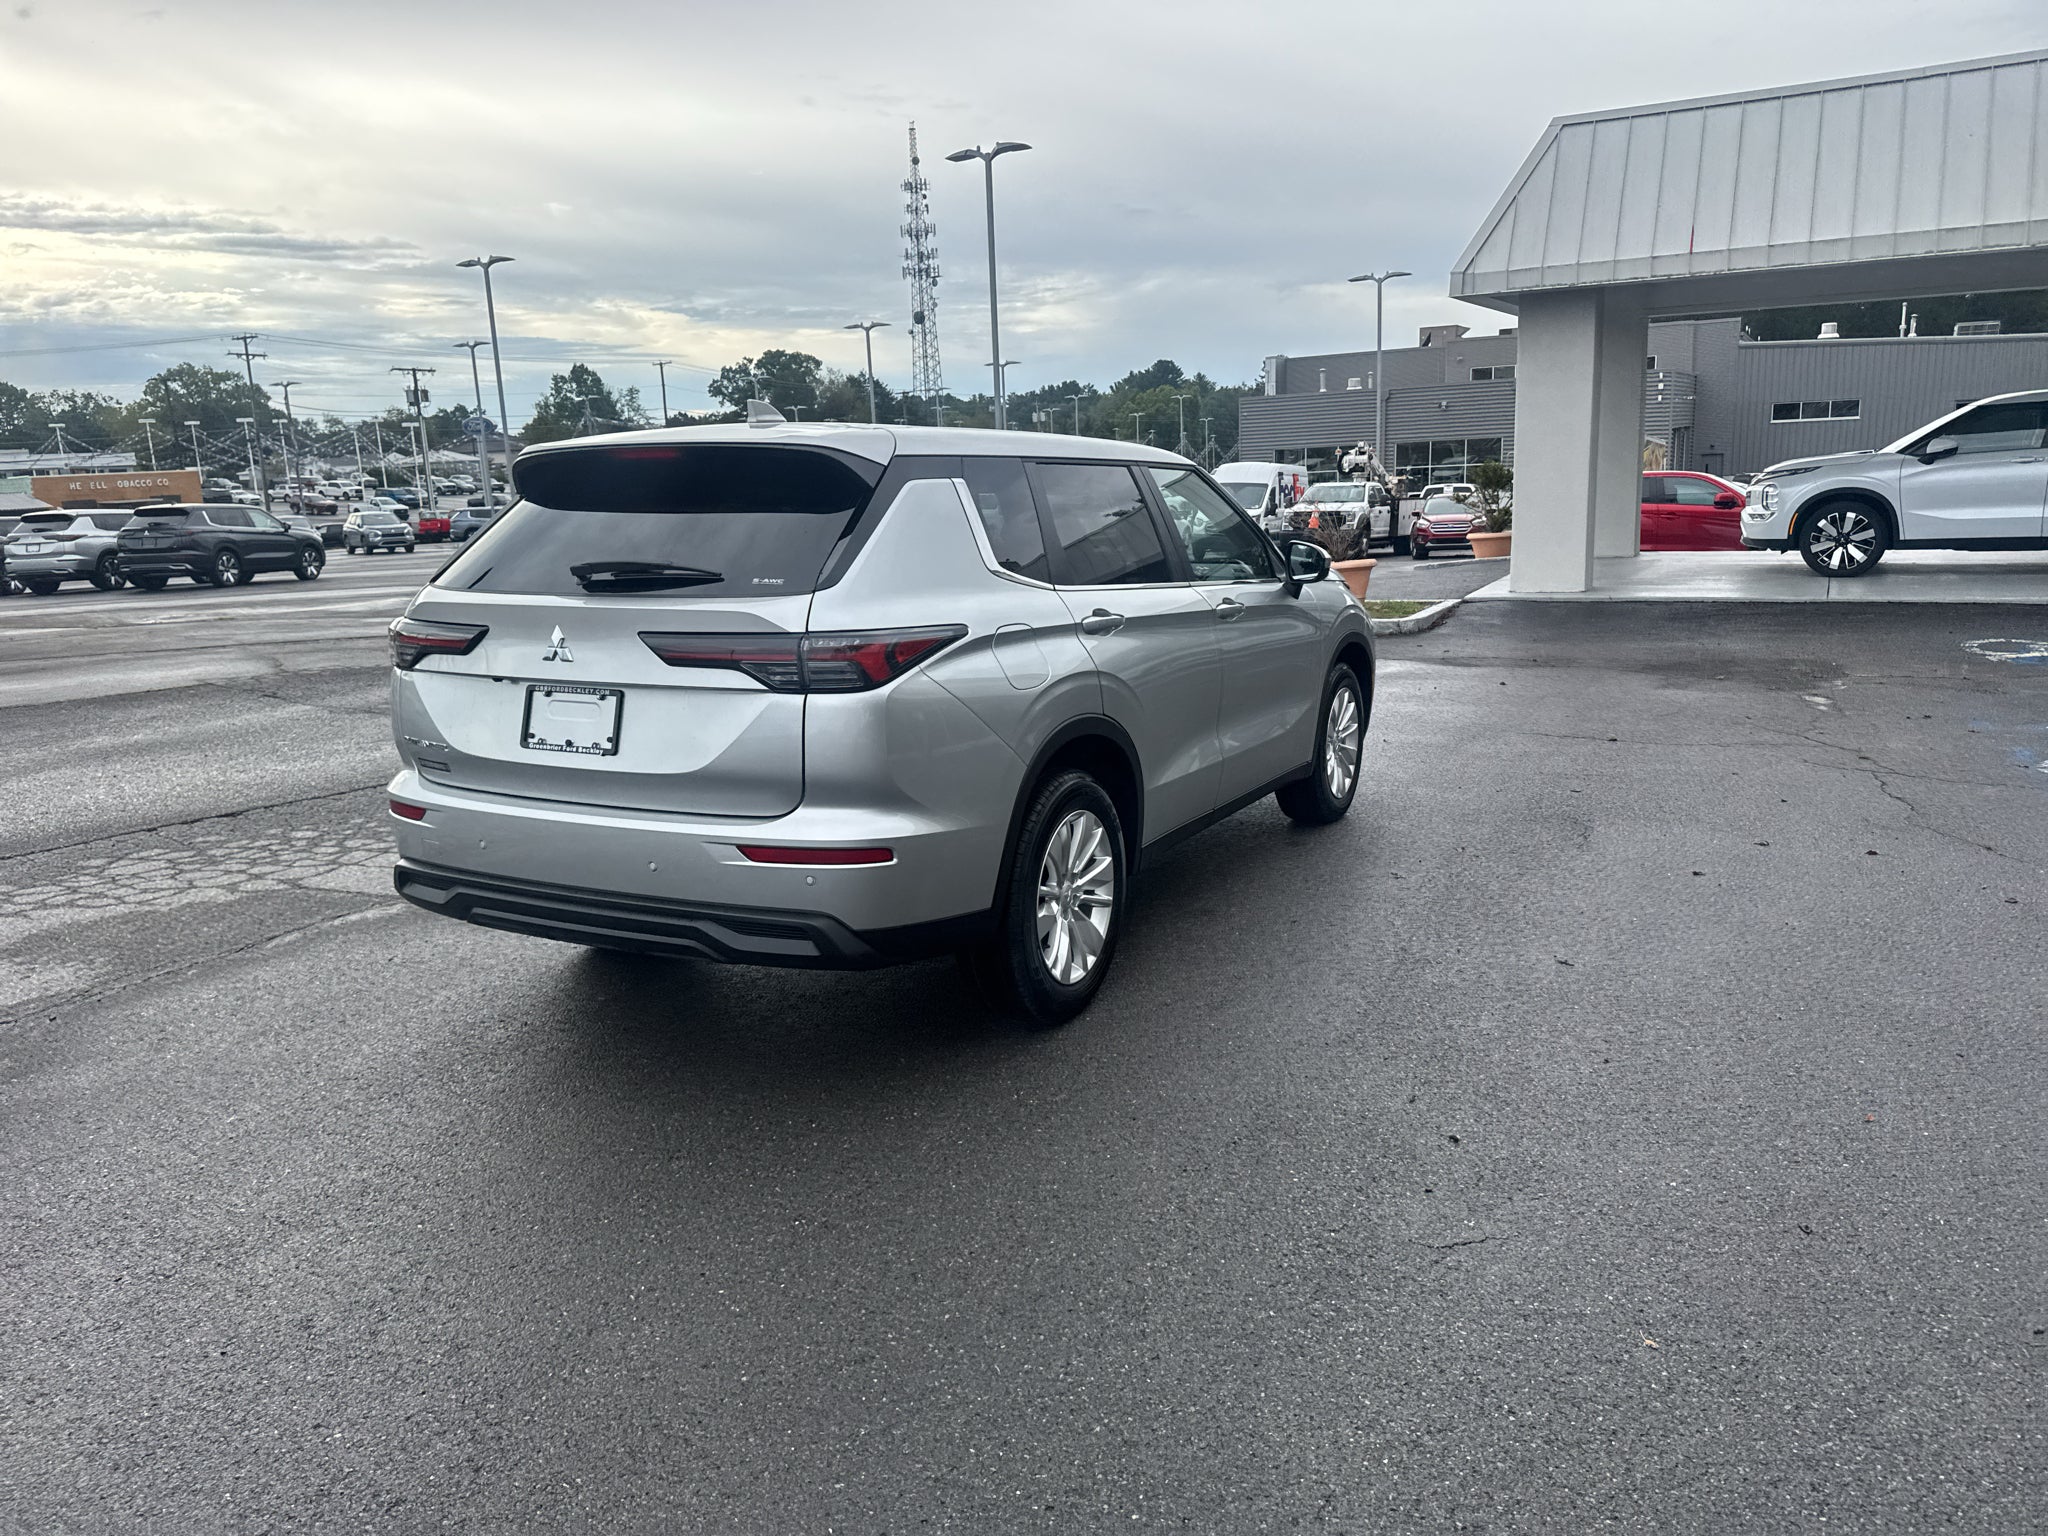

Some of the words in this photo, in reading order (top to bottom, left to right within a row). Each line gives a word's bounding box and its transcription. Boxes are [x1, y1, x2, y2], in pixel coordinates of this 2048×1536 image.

[117, 479, 152, 488] OBACCO
[157, 478, 169, 486] CO
[752, 577, 785, 585] S-AWC
[528, 742, 562, 751] Greenbrier
[578, 746, 604, 756] Beckley
